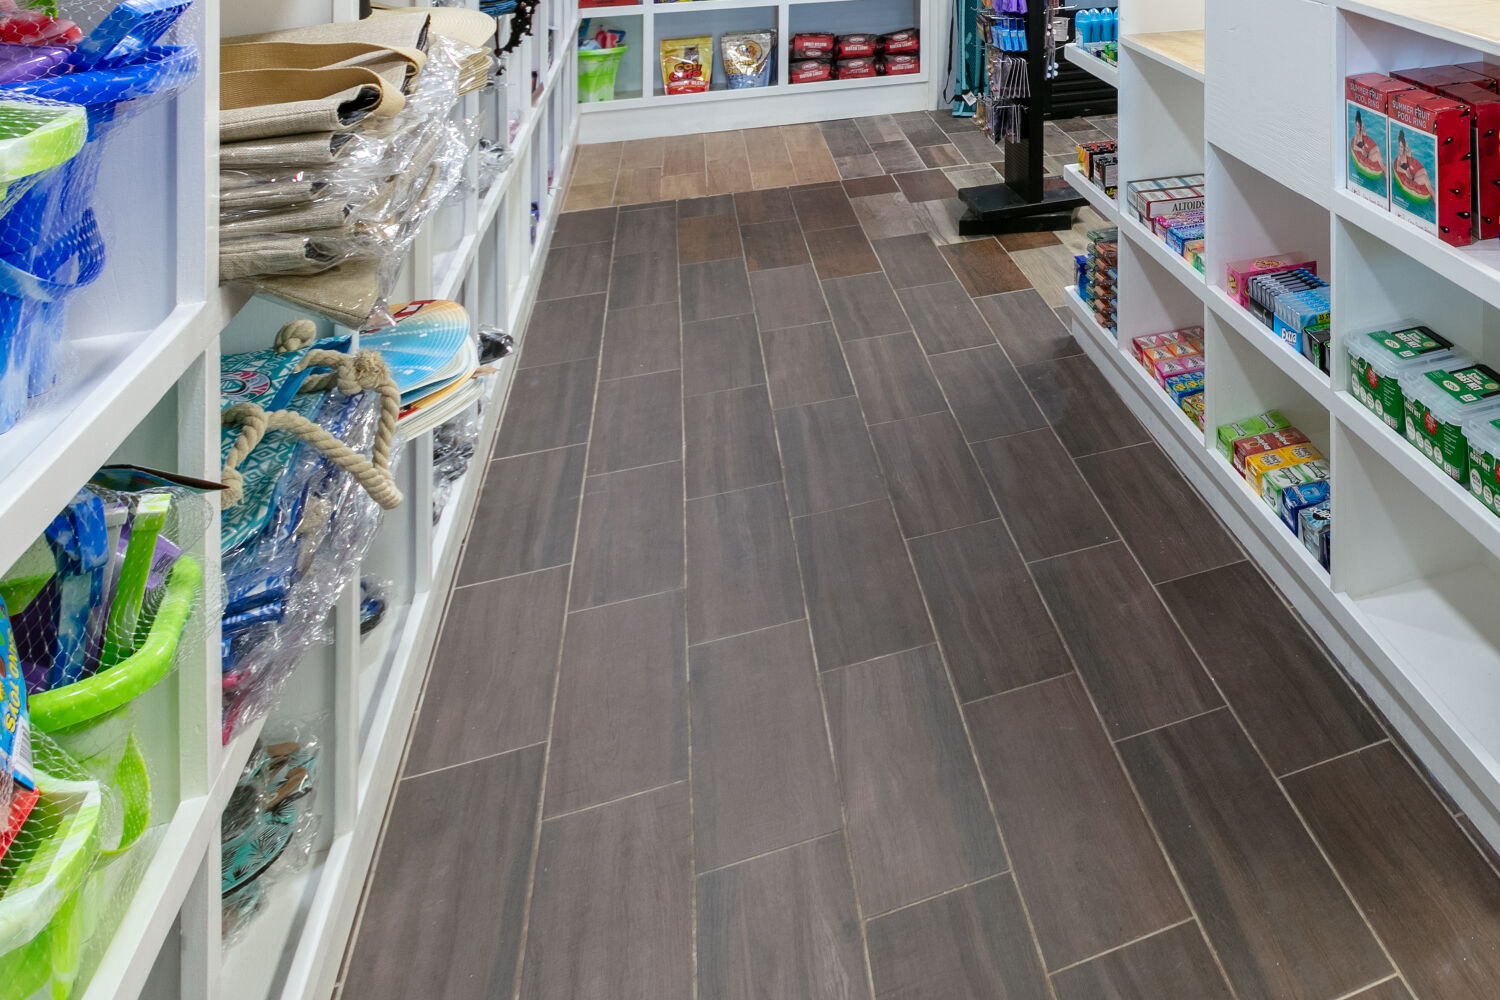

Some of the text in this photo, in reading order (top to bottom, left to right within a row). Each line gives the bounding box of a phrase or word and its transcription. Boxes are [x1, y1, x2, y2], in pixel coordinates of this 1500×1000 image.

[1350, 82, 1383, 102] SUMMER FRUIT
[1354, 93, 1379, 109] POOL RING
[1391, 99, 1431, 121] SUMMER FRUIT
[1397, 111, 1427, 129] POOL RING
[1172, 199, 1205, 211] ALTOIDS
[1281, 327, 1298, 343] Extra
[5, 681, 21, 733] TOYS
